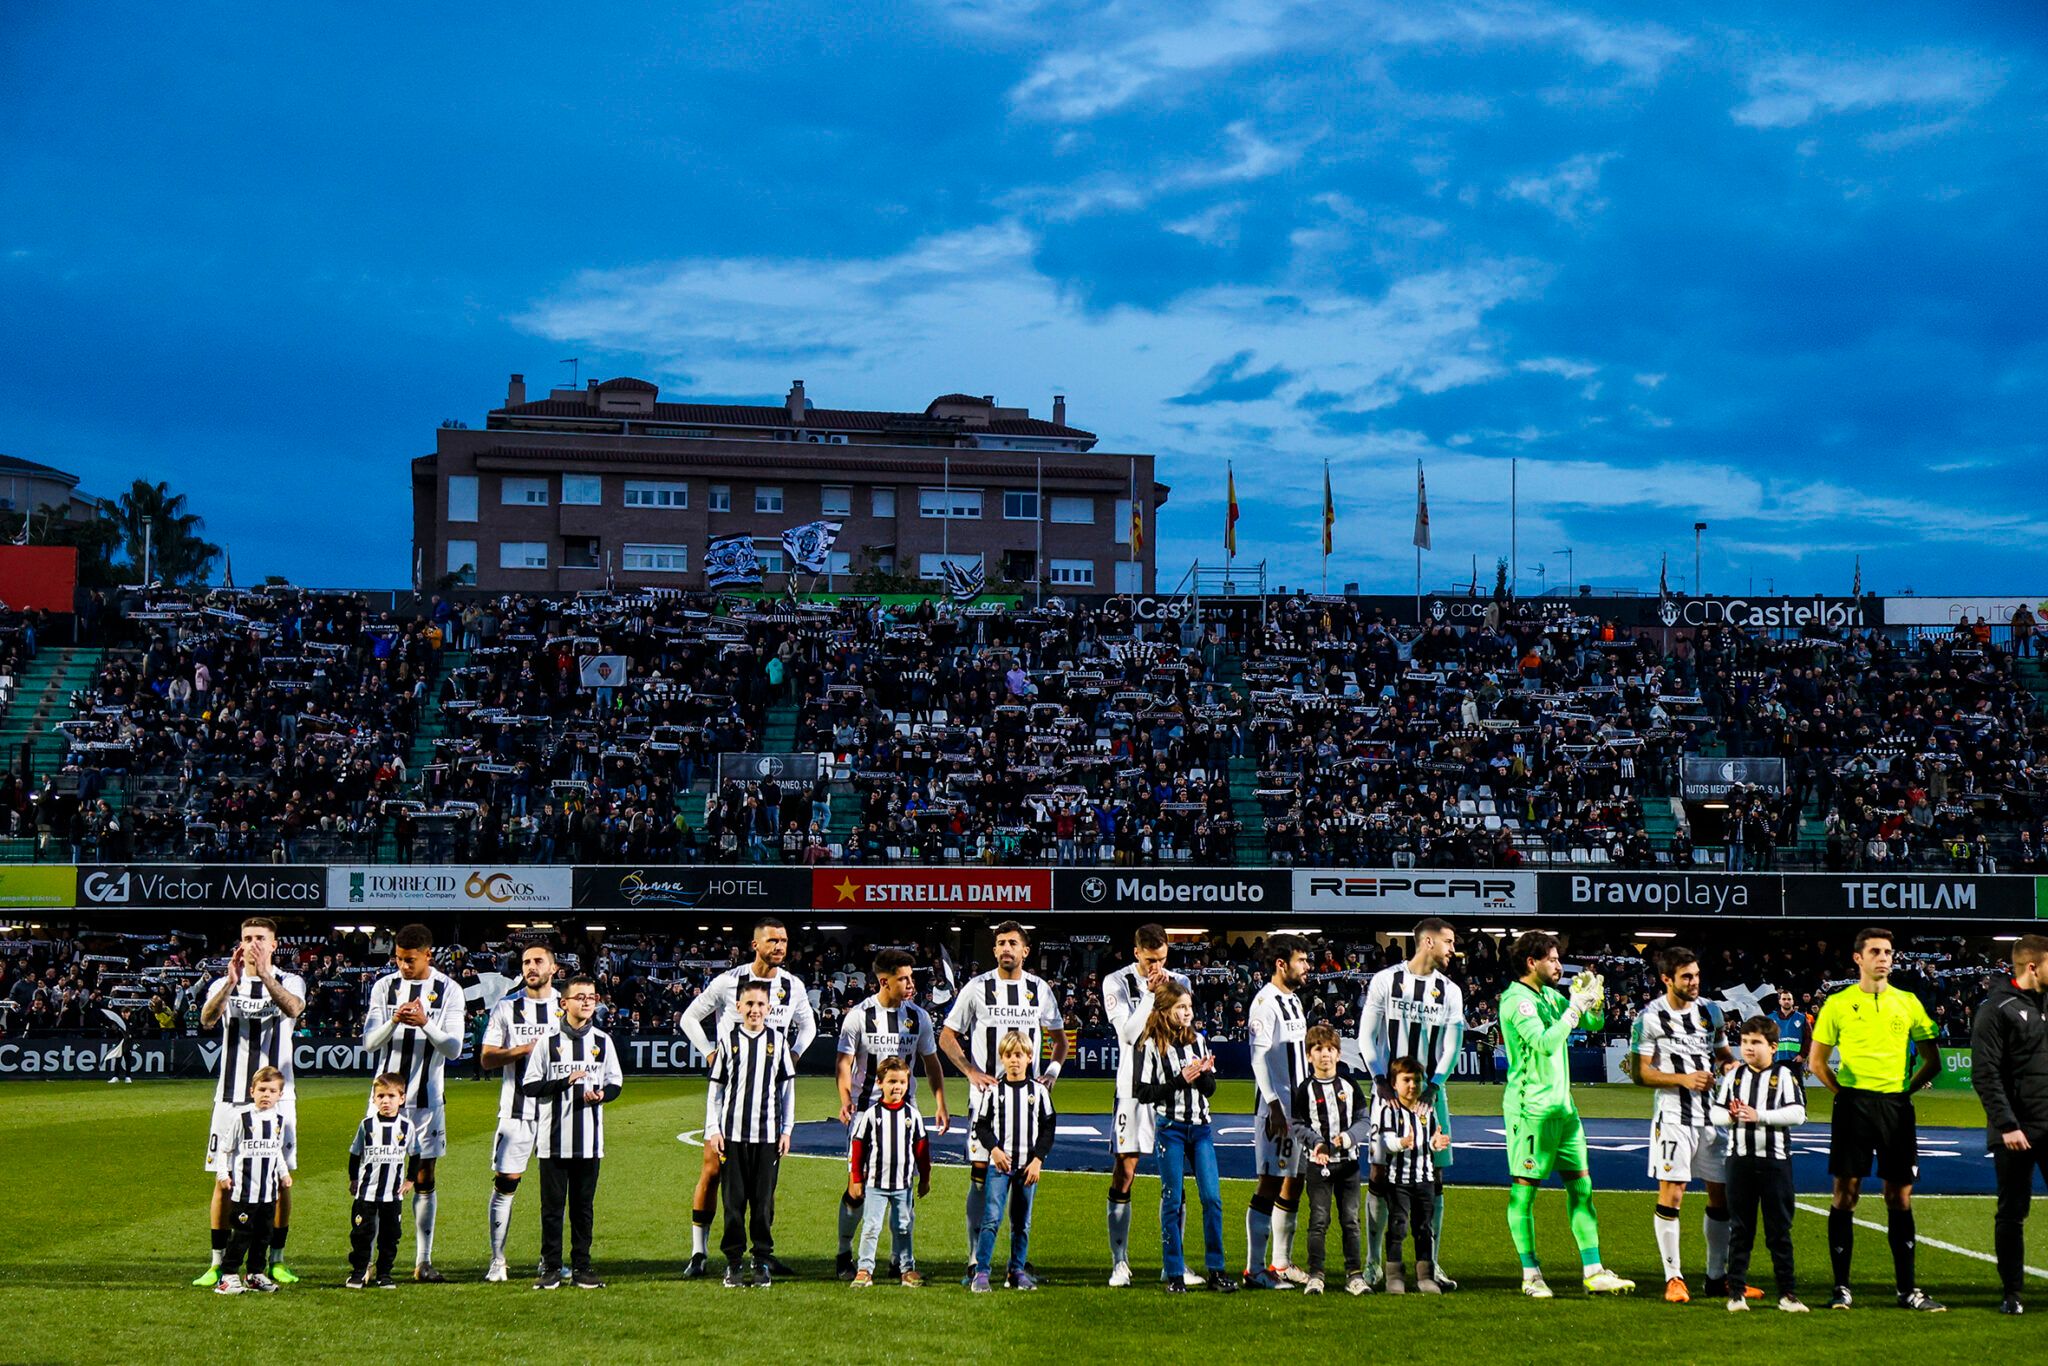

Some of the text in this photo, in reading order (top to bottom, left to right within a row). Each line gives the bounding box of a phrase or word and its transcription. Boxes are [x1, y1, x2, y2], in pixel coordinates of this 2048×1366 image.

[1948, 603, 2031, 622] fruto
[1685, 784, 1709, 794] AUTOS
[139, 873, 320, 900] Víctor Maicas
[368, 875, 456, 891] TORRECID
[497, 880, 535, 896] AÑOS
[709, 880, 769, 895] HOTEL
[865, 884, 1032, 902] ESTRELLA DAMM
[1116, 877, 1264, 902] Maberauto
[1310, 877, 1516, 899] REPCAR
[376, 892, 397, 900] Family
[425, 892, 456, 900] Company
[1571, 875, 1748, 913] Bravoplaya
[1841, 882, 1977, 910] TECHLAM
[988, 1007, 1035, 1017] TECHLAM
[1392, 999, 1439, 1015] TECHLAM
[867, 1035, 914, 1045] TECHLAM
[294, 1044, 377, 1070] cron
[630, 1041, 707, 1069] TECH
[1946, 1052, 1972, 1072] glo
[1275, 1136, 1293, 1158] 18
[1527, 1134, 1534, 1155] 1
[1660, 1140, 1678, 1161] 17
